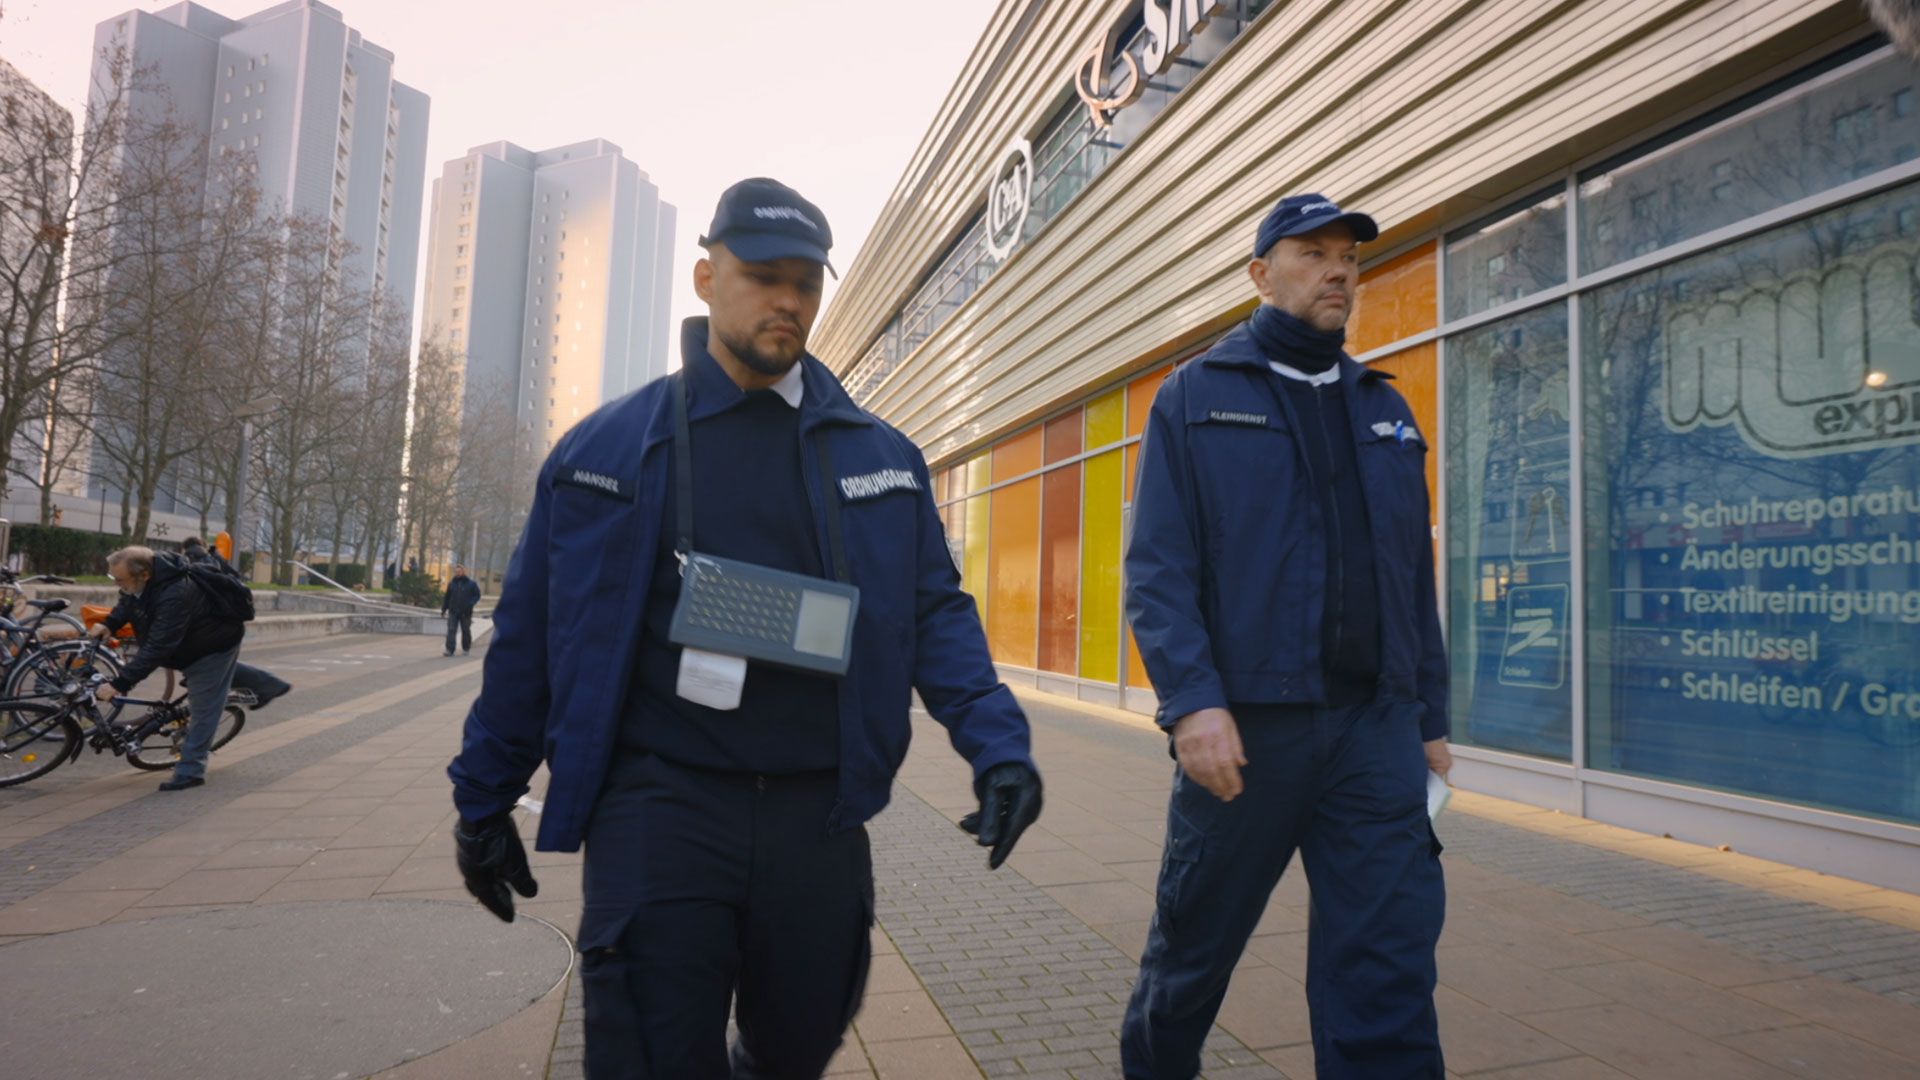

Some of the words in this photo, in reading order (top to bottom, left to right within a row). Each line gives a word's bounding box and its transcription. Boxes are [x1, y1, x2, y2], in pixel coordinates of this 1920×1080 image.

[1210, 409, 1267, 424] KLEINDIENST
[1680, 532, 1920, 576] Änderungssch
[1680, 583, 1920, 623] Textilreinigung
[1681, 629, 1818, 662] Schlüssel
[1681, 672, 1822, 710] Schleifen
